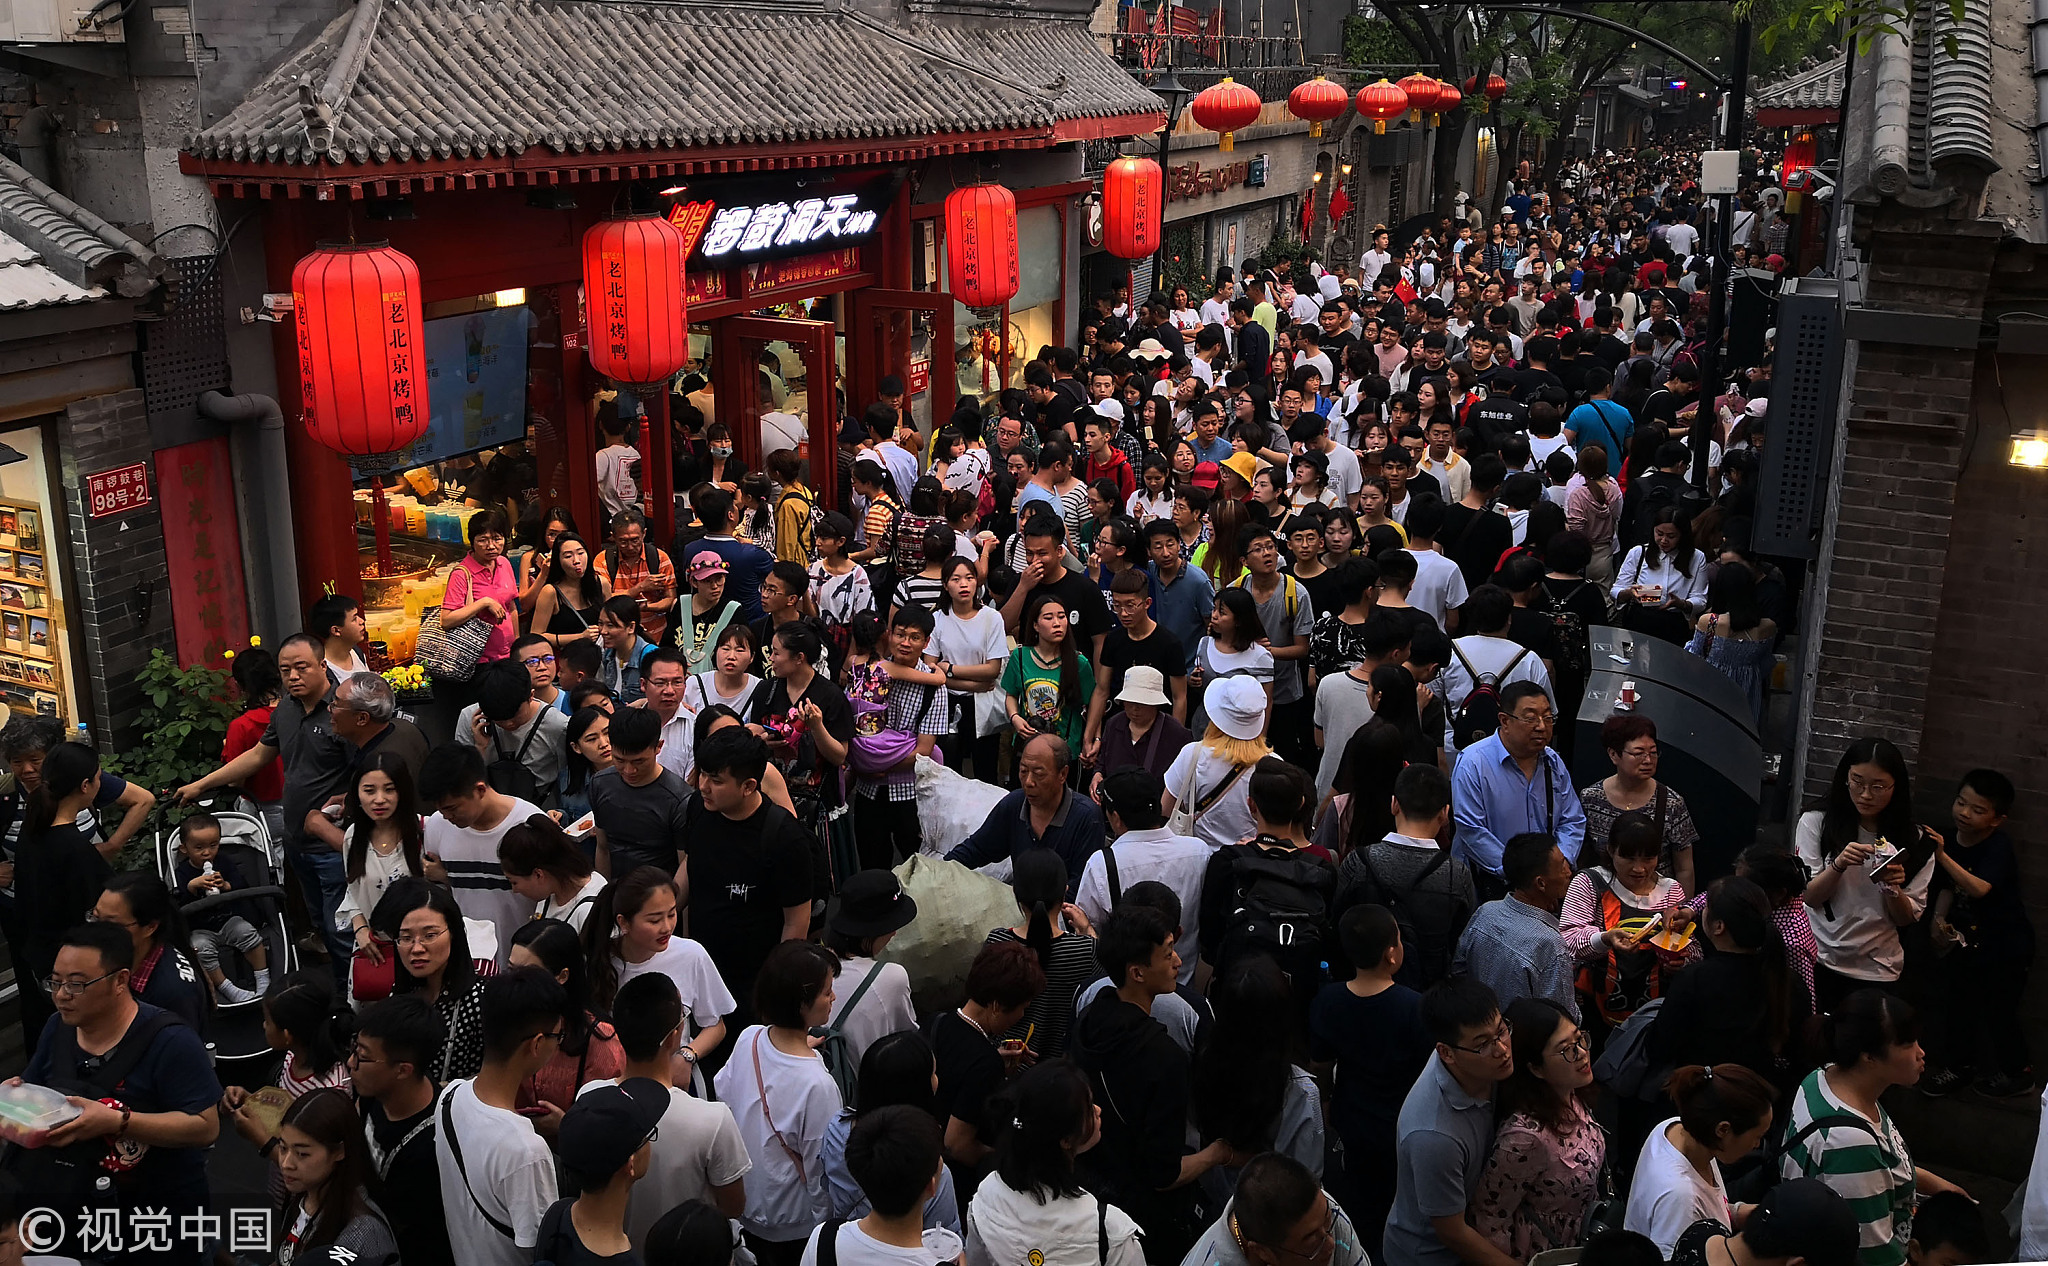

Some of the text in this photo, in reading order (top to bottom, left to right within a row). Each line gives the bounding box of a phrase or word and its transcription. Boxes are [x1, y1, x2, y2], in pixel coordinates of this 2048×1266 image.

[702, 194, 859, 257] 锣鼓洞天
[1135, 184, 1146, 244] 老北京烤鸭
[964, 217, 978, 291] 老北京烤鸭
[607, 261, 628, 360] 老北京烤鸭
[388, 303, 414, 425] 老北京烤鸭
[1480, 410, 1514, 421] 东旭佳业
[93, 469, 144, 492] 南锣鼓巷
[95, 484, 146, 512] 98号-2
